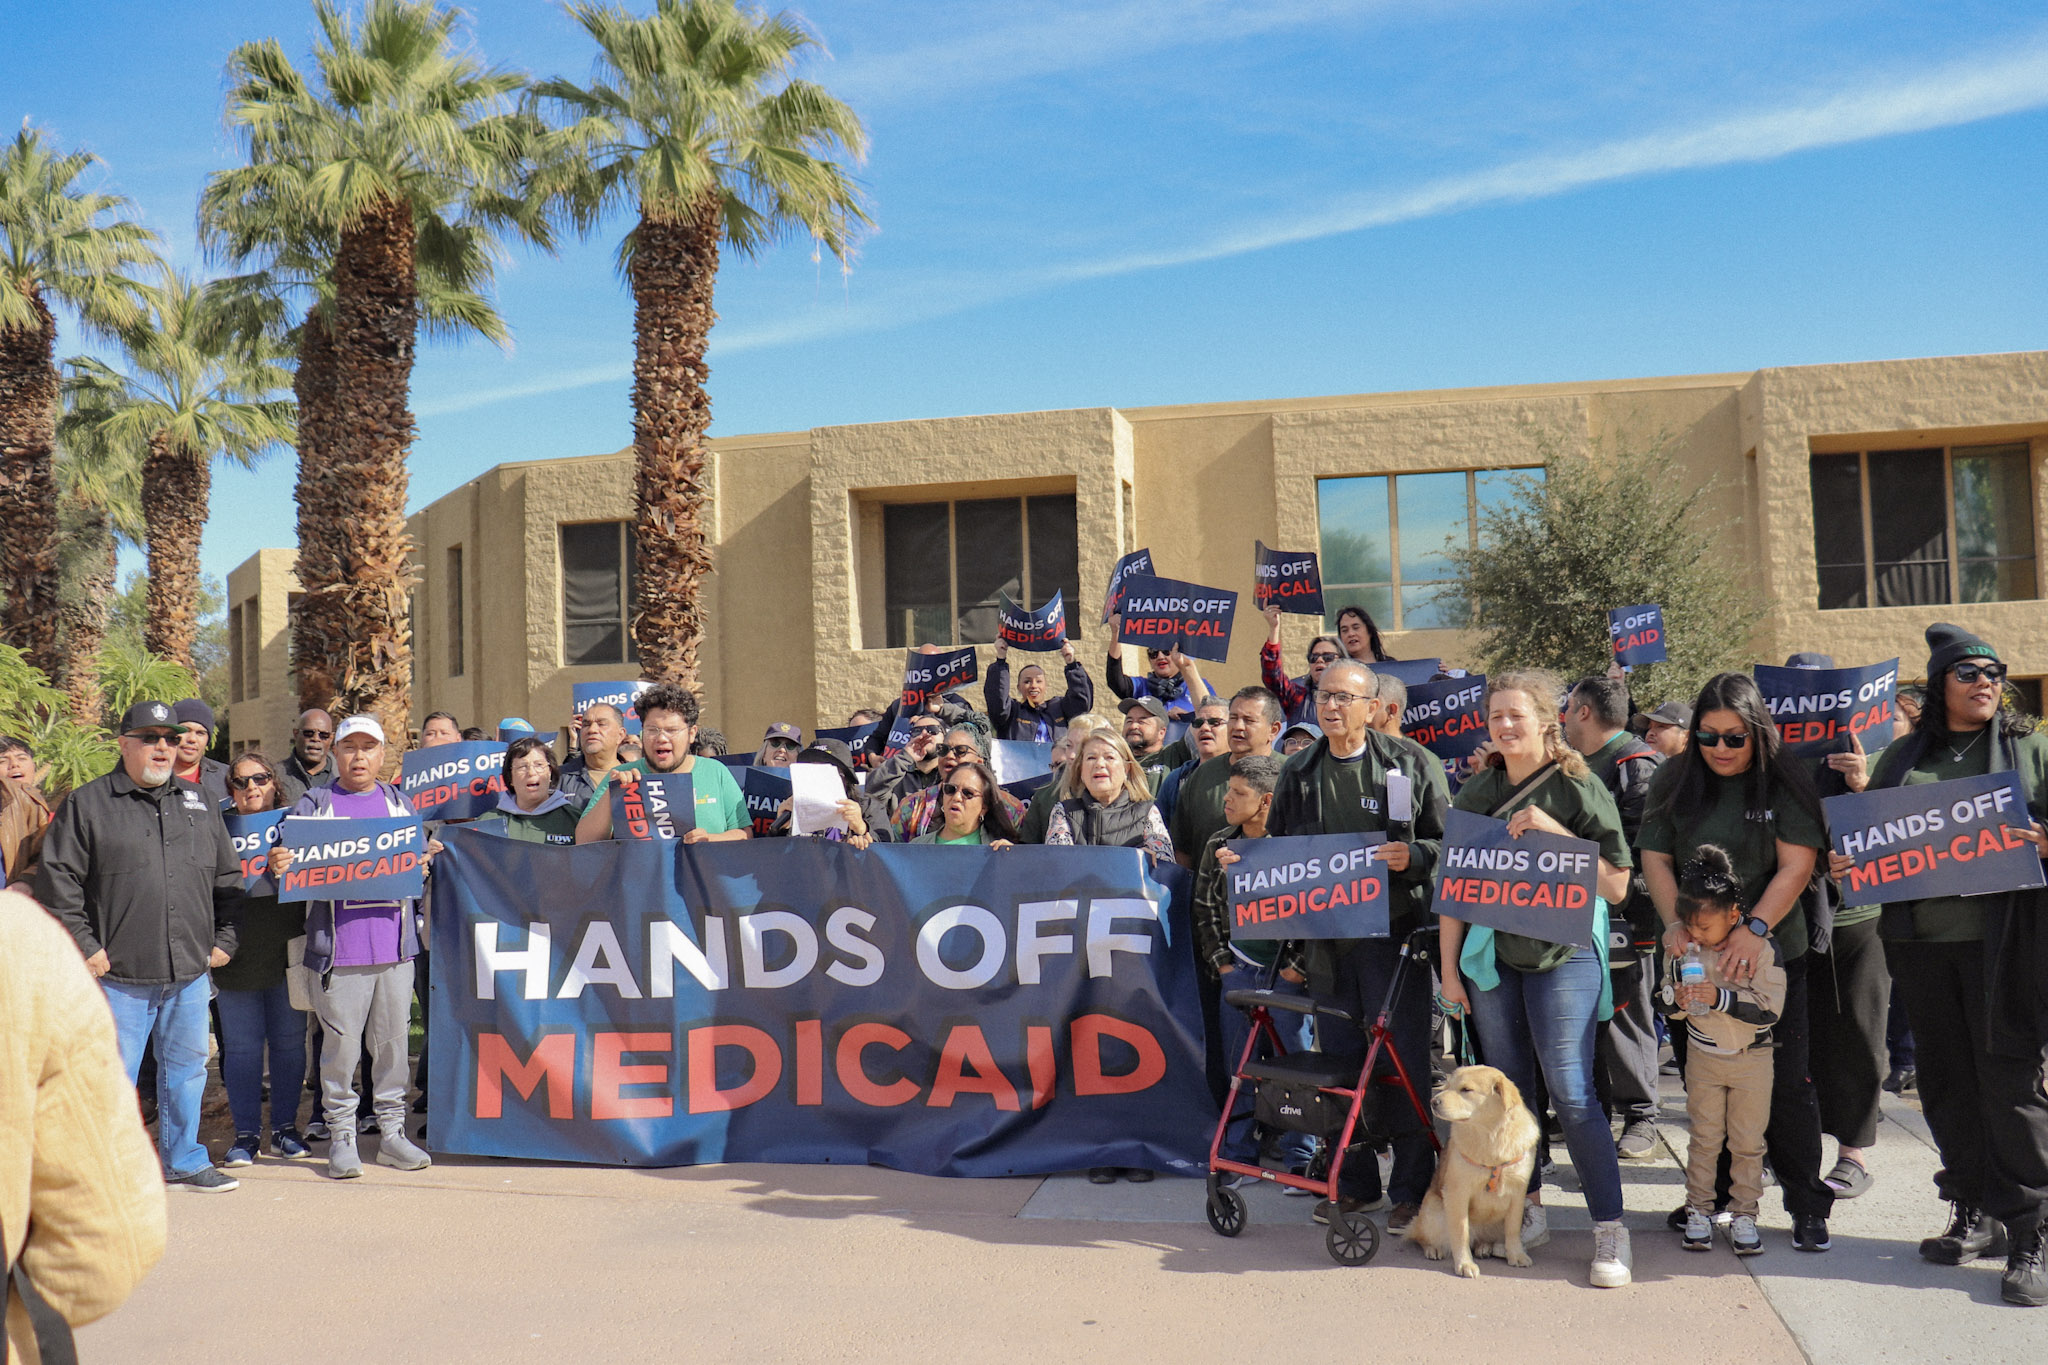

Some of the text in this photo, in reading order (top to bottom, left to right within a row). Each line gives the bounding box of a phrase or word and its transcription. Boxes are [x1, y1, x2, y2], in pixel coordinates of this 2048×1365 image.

[1281, 560, 1312, 577] OFF
[1000, 609, 1045, 631] HANDS
[1127, 597, 1189, 613] HANDS
[1192, 599, 1231, 614] OFF
[1624, 611, 1656, 630] OFF
[1124, 618, 1226, 637] MEDI-CAL
[936, 654, 971, 677] OFF
[1444, 685, 1482, 711] OFF
[1763, 670, 1895, 715] HANDS OFF
[405, 758, 471, 790] HANDS
[646, 780, 676, 839] HAND
[1842, 786, 2013, 856] HANDS OFF
[289, 825, 417, 864] HANDS OFF
[1446, 847, 1591, 875] HANDS OFF
[1850, 823, 2025, 893] MEDI-CAL
[285, 851, 417, 892] MEDICAID
[1234, 845, 1379, 894] HANDS OFF
[1235, 877, 1381, 927] MEDICAID
[1440, 877, 1589, 910] MEDICAID
[474, 898, 1159, 1001] HANDS OFF
[475, 1013, 1167, 1121] MEDICAID
